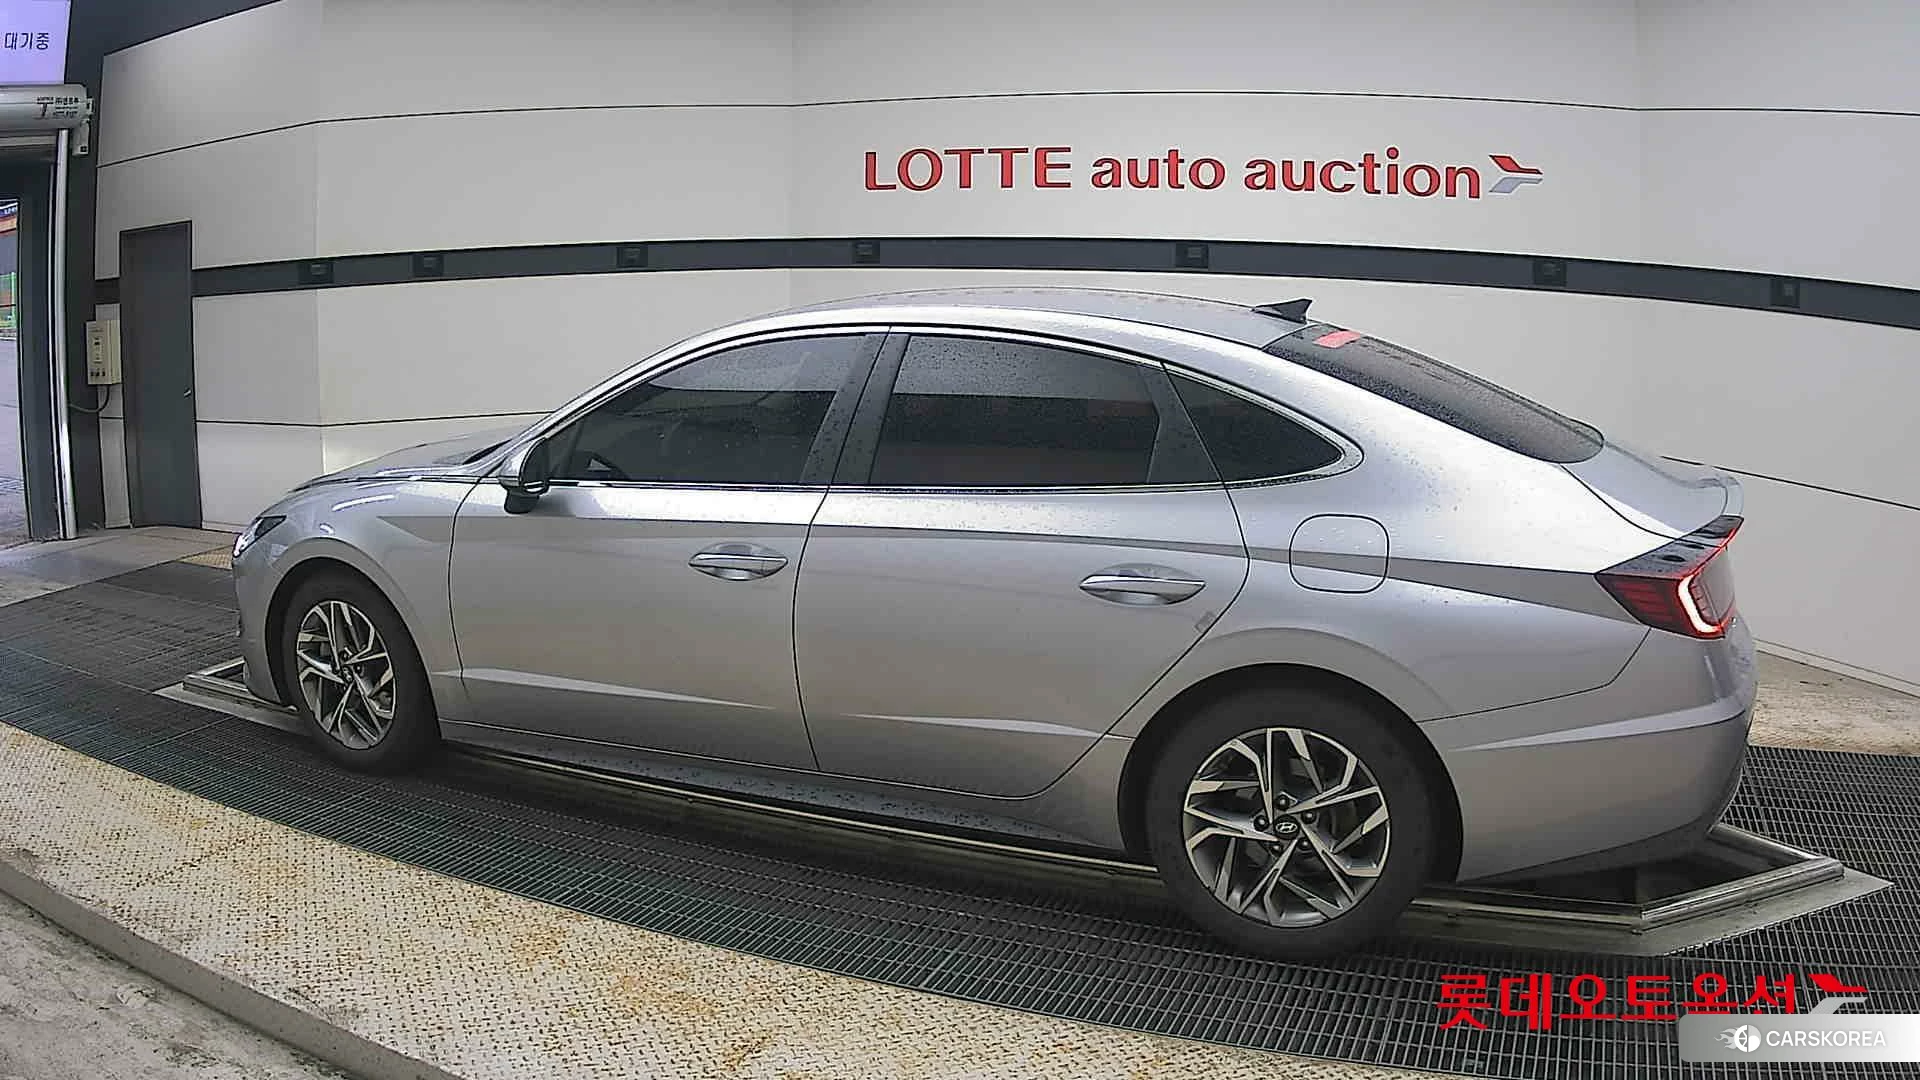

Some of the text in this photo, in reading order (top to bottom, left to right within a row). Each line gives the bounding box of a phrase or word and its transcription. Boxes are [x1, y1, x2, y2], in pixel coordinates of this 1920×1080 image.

[4, 32, 50, 51] 대기중
[864, 146, 1481, 199] LOTTE auto auction
